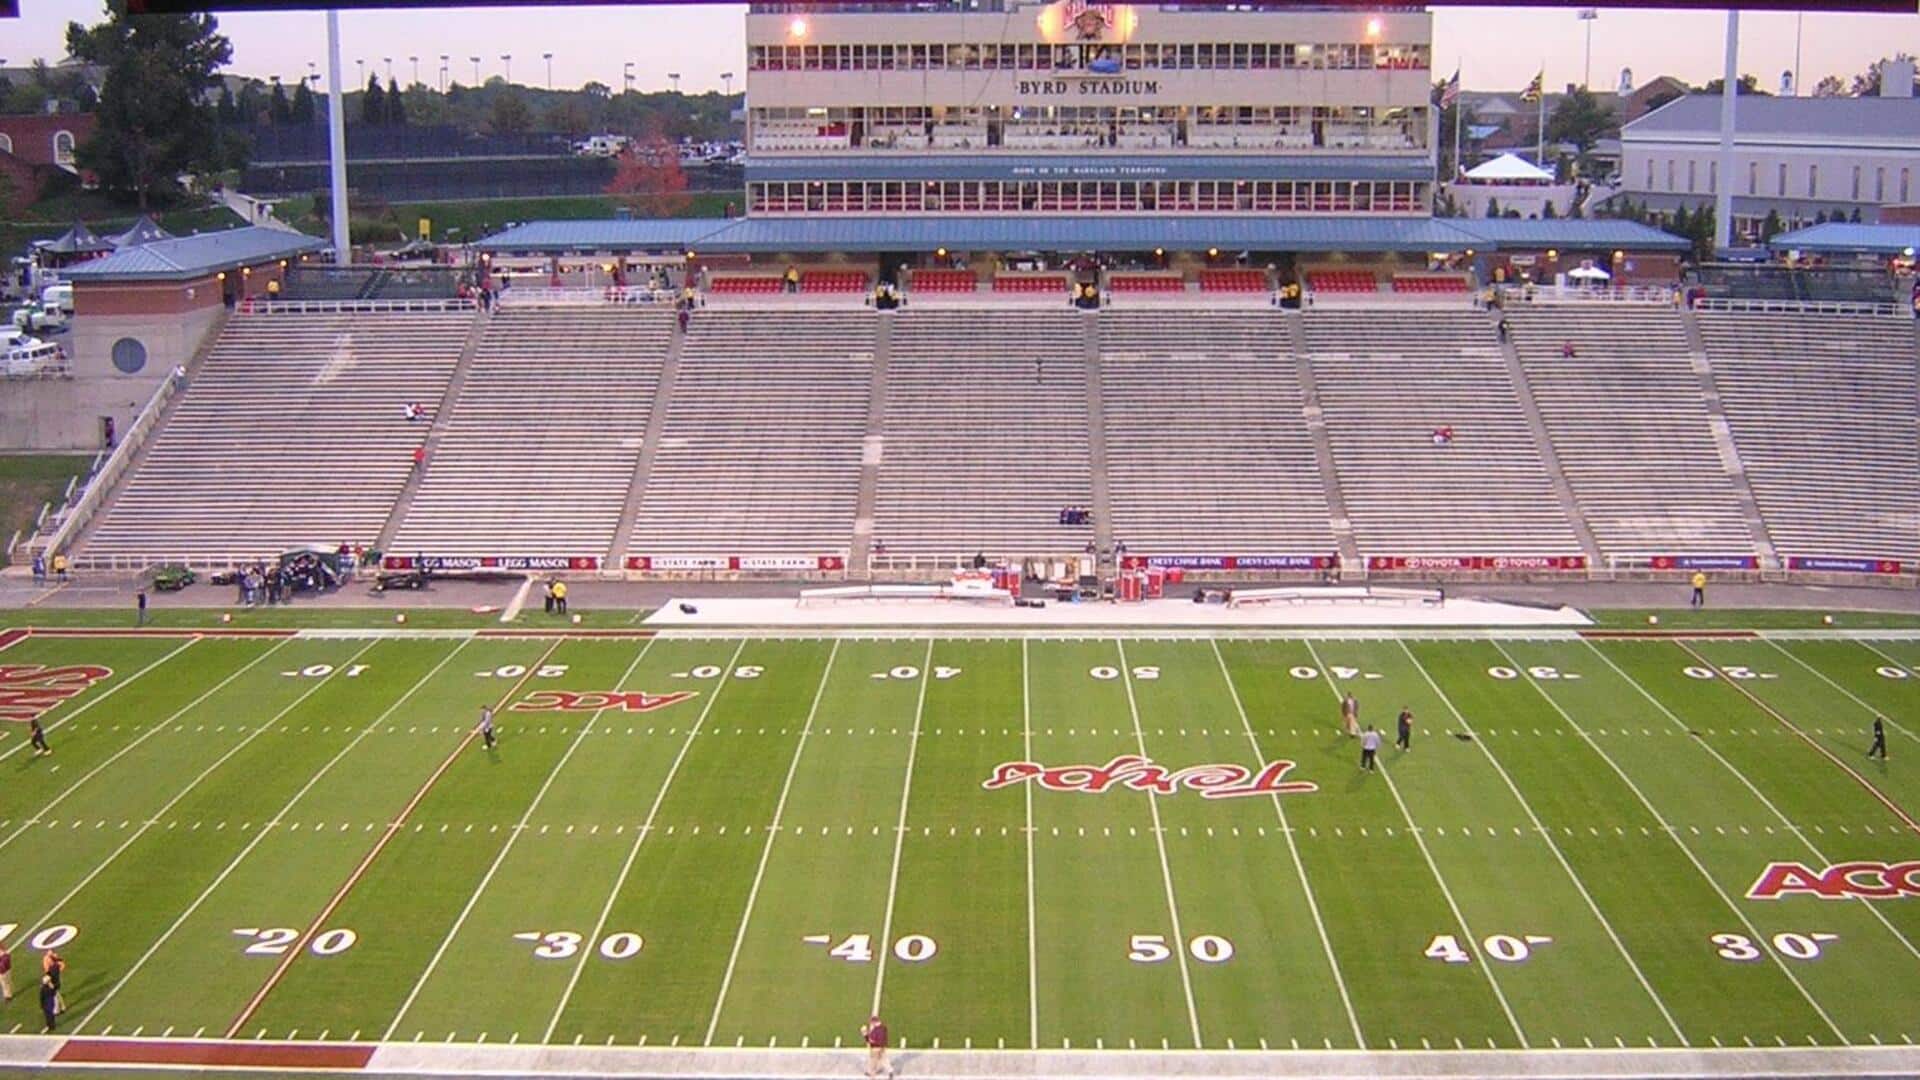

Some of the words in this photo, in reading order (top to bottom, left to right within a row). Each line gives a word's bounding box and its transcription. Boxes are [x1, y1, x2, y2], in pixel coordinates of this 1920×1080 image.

[1019, 80, 1067, 95] BYRD
[1079, 80, 1157, 95] STADIUM
[441, 558, 483, 568] MASON
[497, 558, 527, 568] LEGG
[528, 558, 569, 568] MASON
[1420, 558, 1461, 567] TOYOTA
[1509, 558, 1549, 567] TOYOTA
[507, 690, 700, 712] ACC
[982, 754, 1318, 799] Terps
[244, 928, 357, 955] 20
[534, 931, 643, 958] 30
[831, 935, 938, 961] 40
[1128, 935, 1234, 962] 50
[1424, 935, 1530, 963] 40
[1711, 933, 1822, 960] 30
